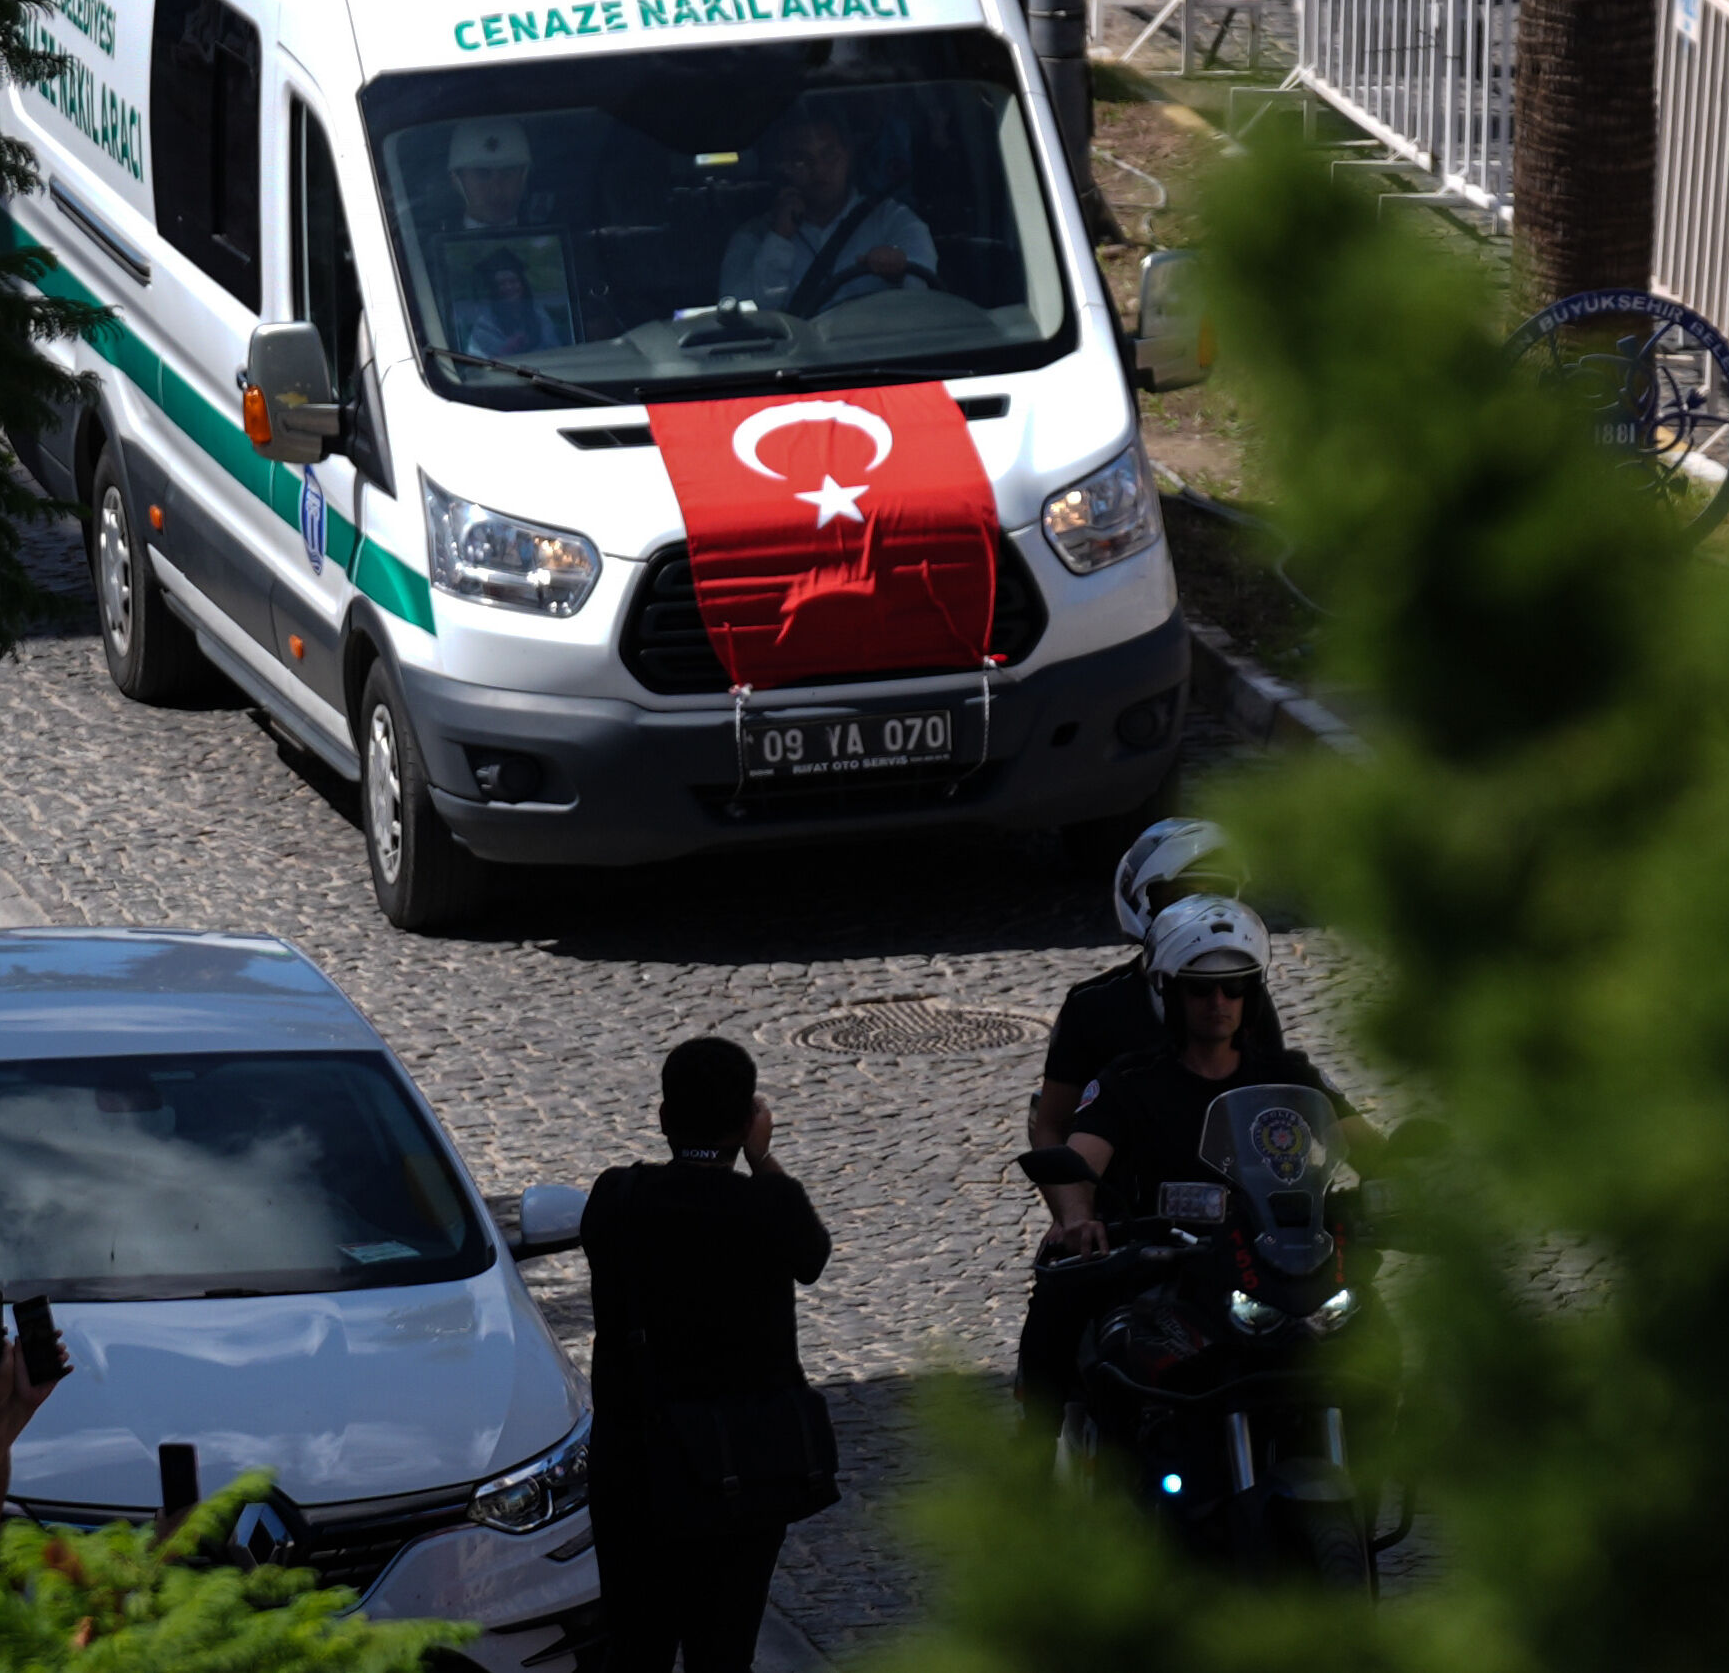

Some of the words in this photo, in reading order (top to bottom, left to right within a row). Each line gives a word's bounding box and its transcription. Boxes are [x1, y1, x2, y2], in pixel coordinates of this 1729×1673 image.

[452, 0, 628, 51] CENAZE
[102, 82, 144, 184] ARACI
[762, 727, 804, 762] 09
[825, 722, 865, 757] YA
[883, 715, 945, 751] 070
[832, 758, 860, 771] OTO
[681, 1149, 720, 1159] SONY
